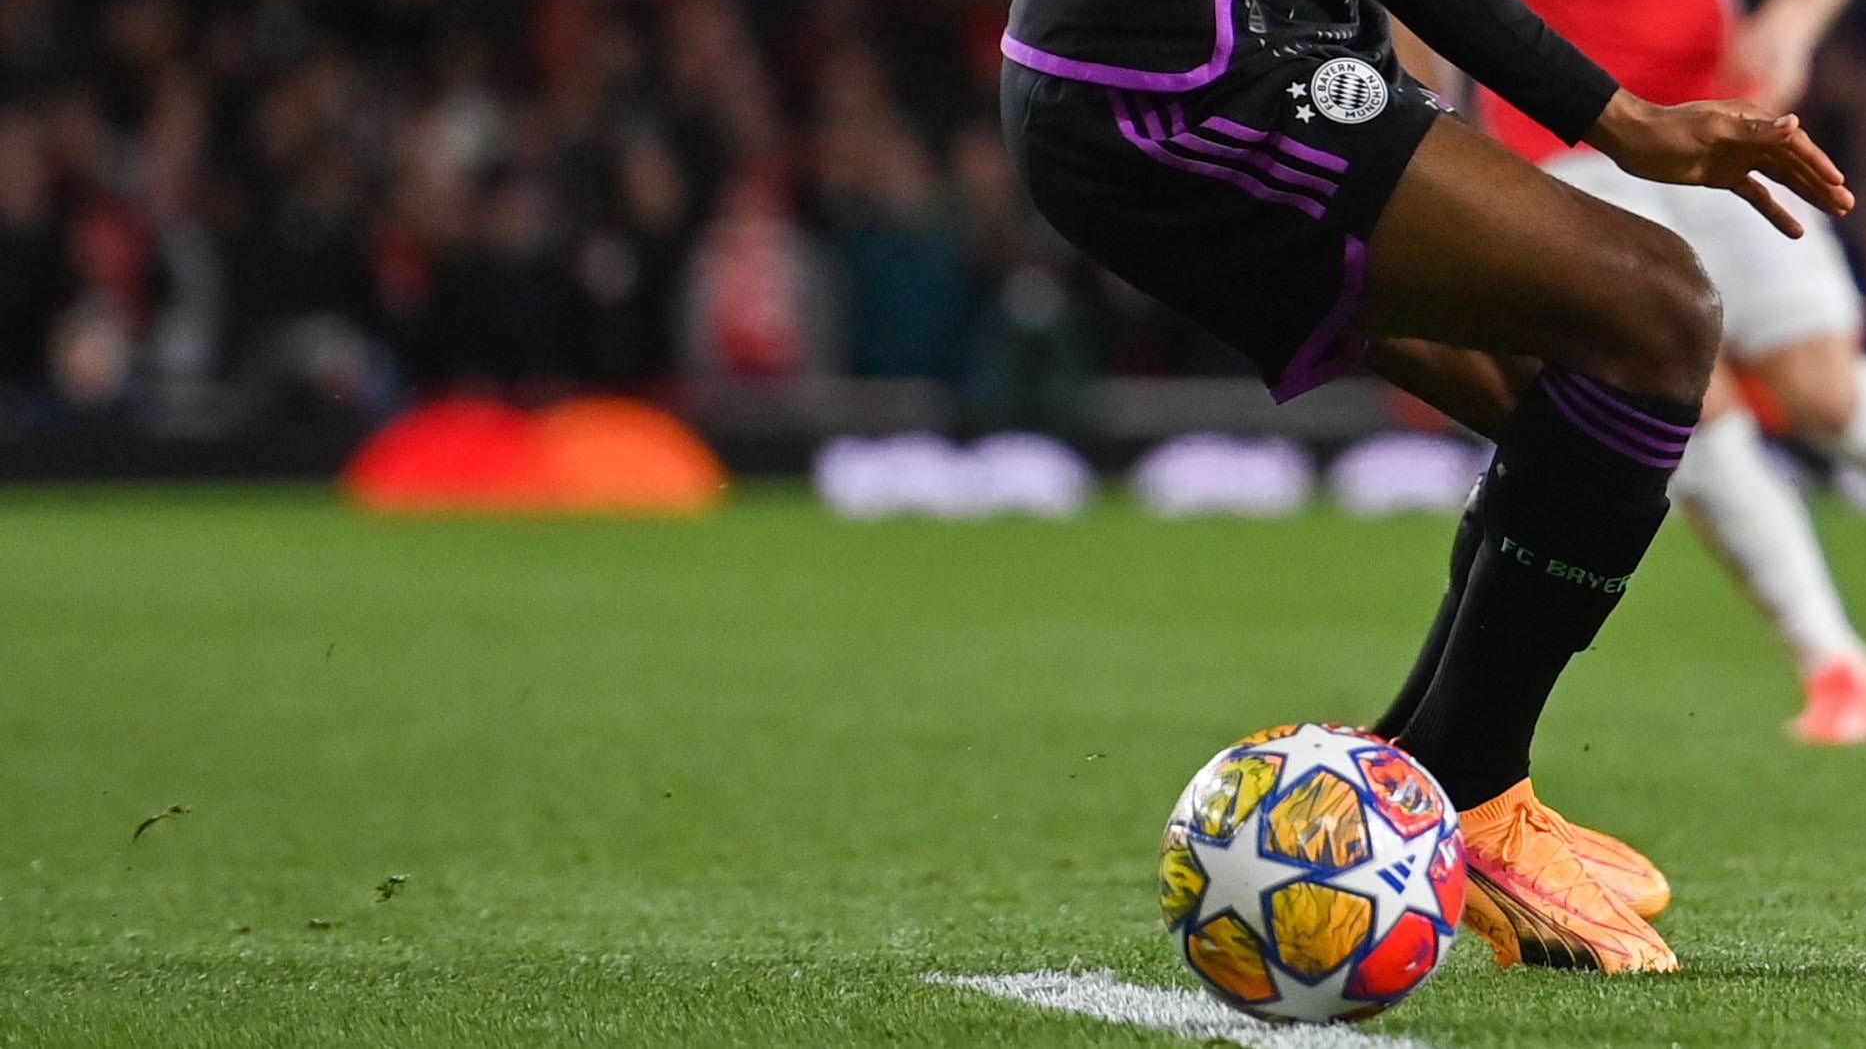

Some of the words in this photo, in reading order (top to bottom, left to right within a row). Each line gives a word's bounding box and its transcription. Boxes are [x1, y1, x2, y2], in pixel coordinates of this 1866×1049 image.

[1317, 63, 1356, 92] BAYERN
[1319, 94, 1334, 111] FC
[1500, 536, 1535, 565] FC
[1545, 559, 1633, 594] BAYER
